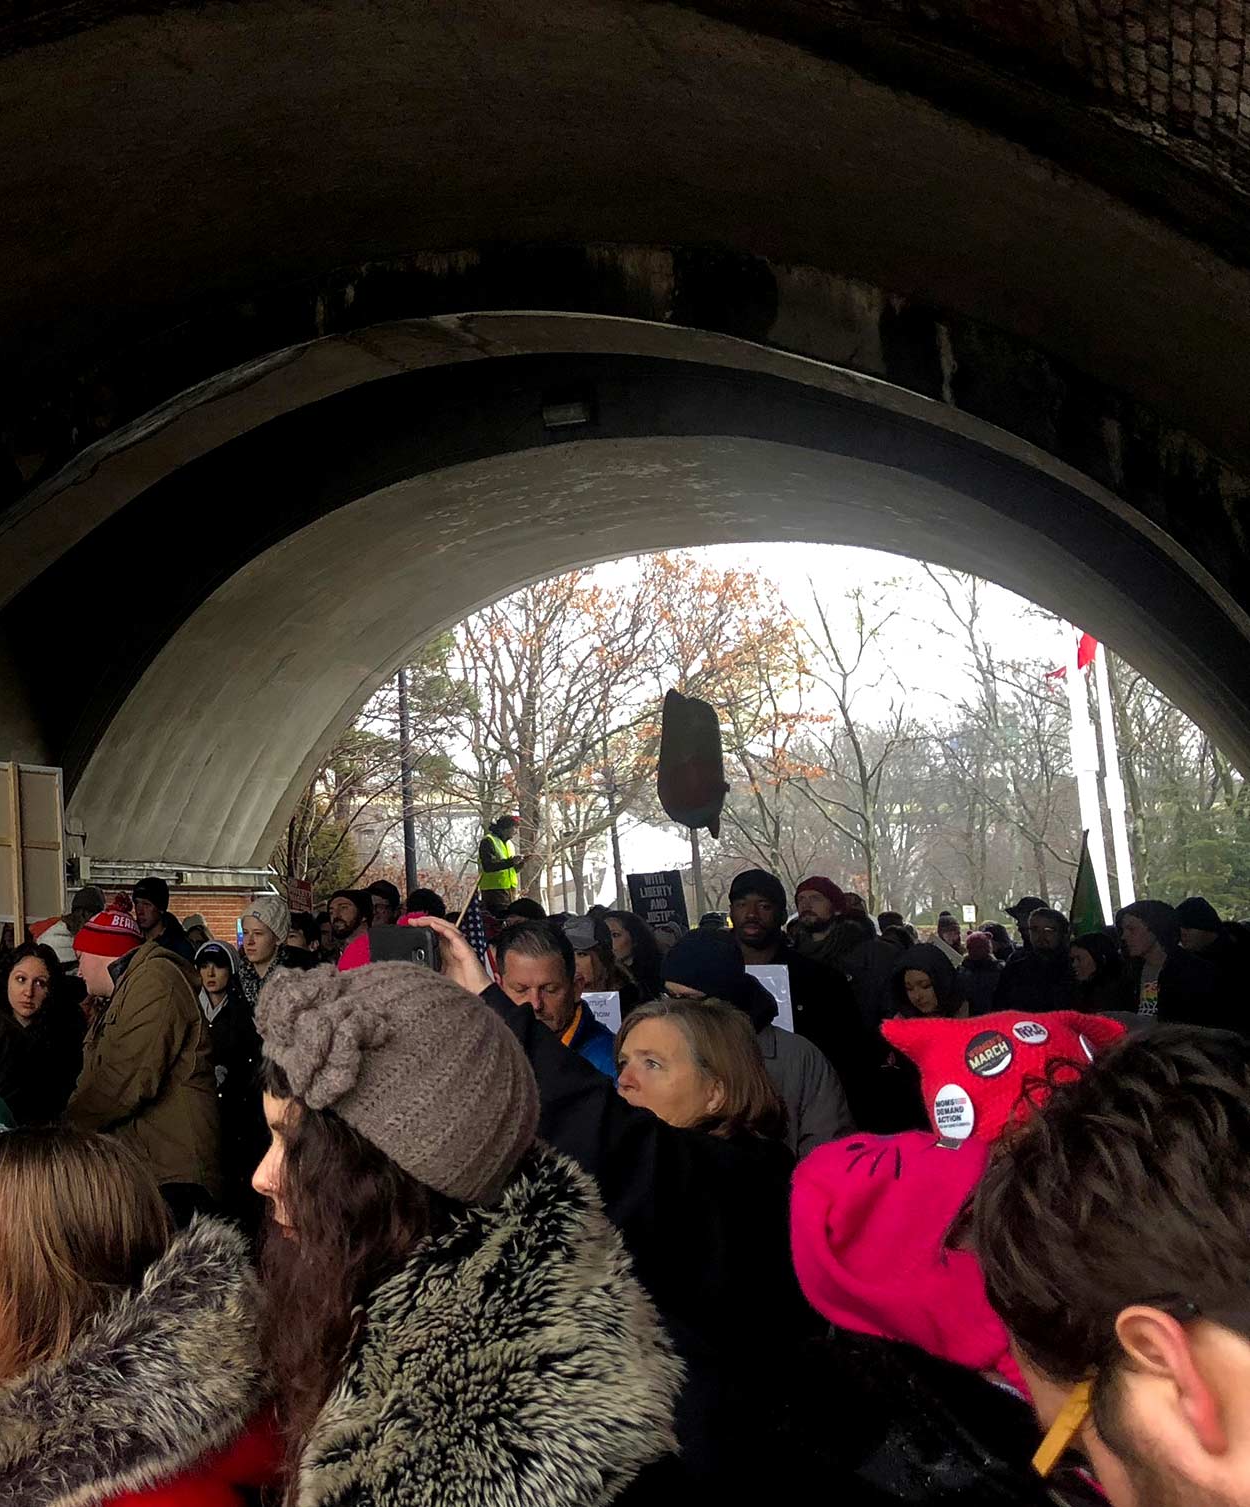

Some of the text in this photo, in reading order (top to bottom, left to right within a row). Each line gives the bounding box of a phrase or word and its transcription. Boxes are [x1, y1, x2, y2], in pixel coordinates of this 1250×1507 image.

[643, 873, 665, 885] WITH
[639, 885, 672, 898] LIBERTY
[650, 898, 668, 910] AND
[968, 1041, 1009, 1070] MARCH
[935, 1099, 954, 1108] MOMS
[936, 1106, 964, 1115] DEMAND
[938, 1115, 962, 1123] ACTION
